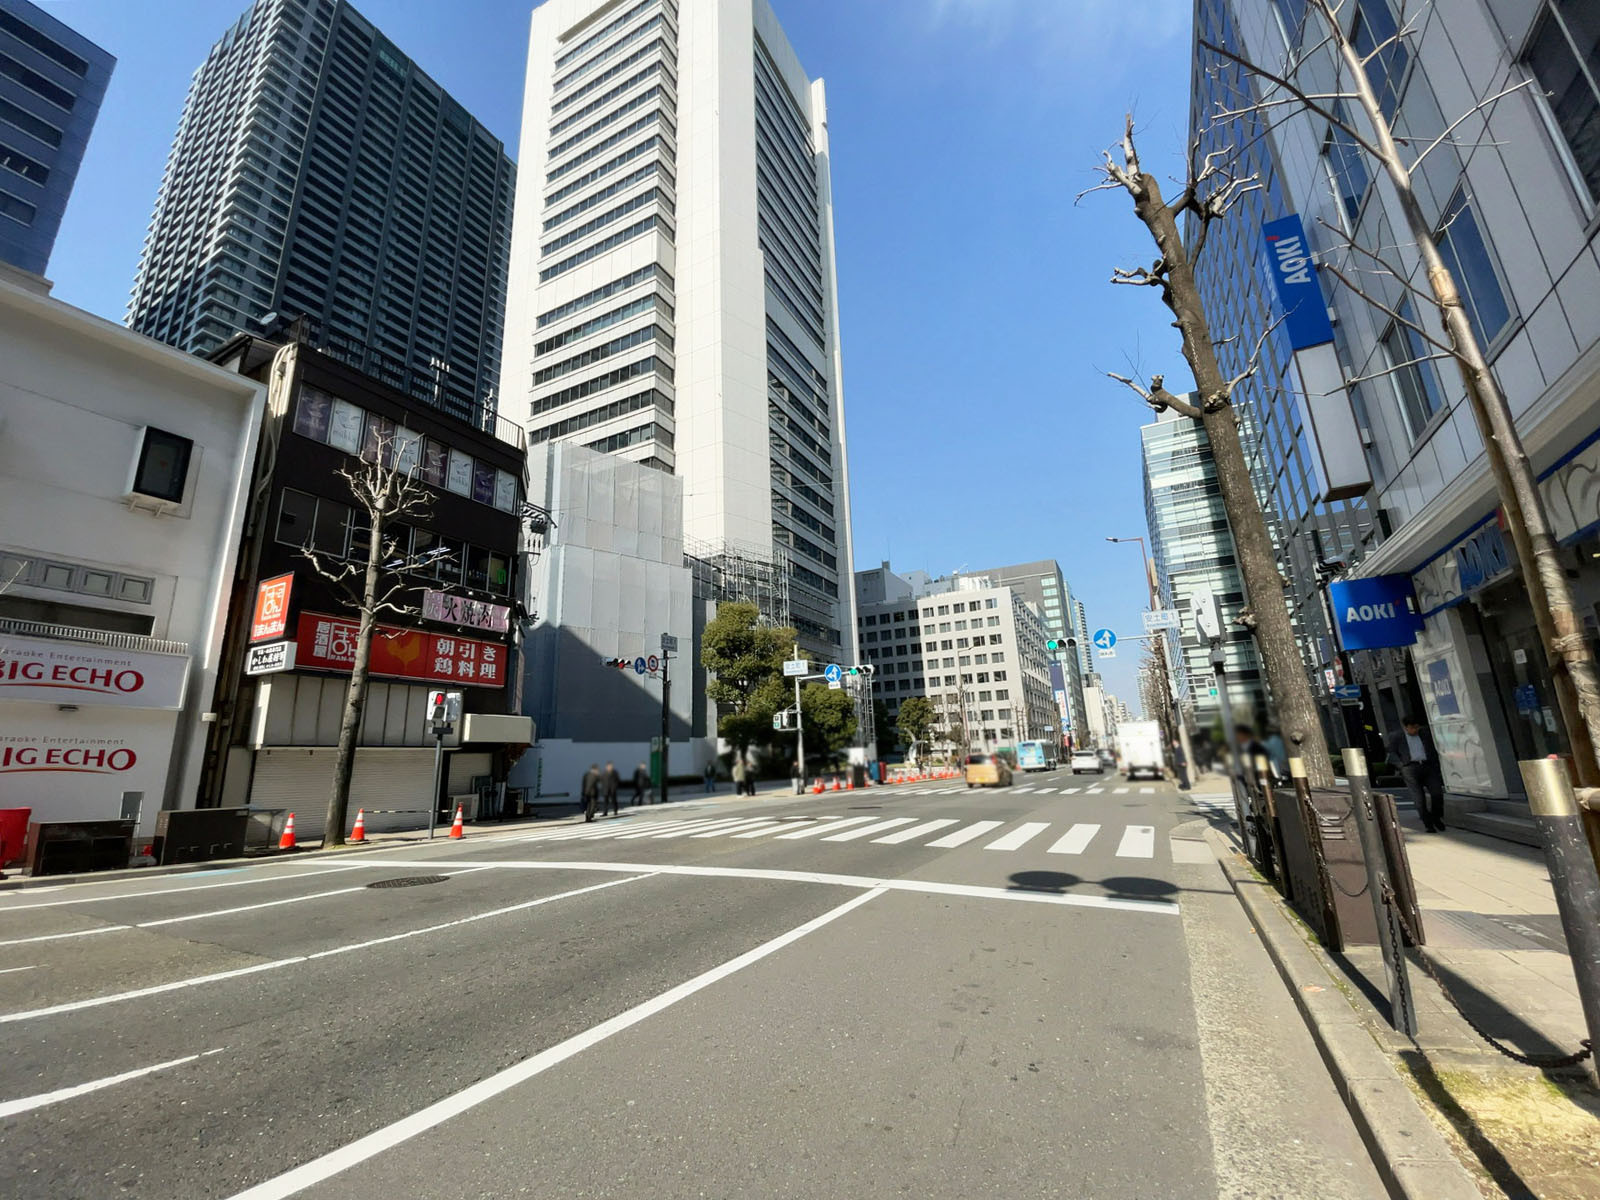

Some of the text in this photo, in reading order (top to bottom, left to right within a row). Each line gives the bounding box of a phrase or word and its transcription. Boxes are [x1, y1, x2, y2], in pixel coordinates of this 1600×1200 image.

[1274, 235, 1311, 284] AOKI
[1457, 524, 1509, 592] AOKI
[1346, 603, 1396, 623] AOKI
[312, 621, 331, 658] 居酒屋
[436, 638, 497, 661] 朝引き
[50, 652, 131, 666] Entertainment
[433, 657, 497, 678] 鶏料理
[52, 665, 144, 692] ECHO
[43, 736, 124, 745] Entertainment
[46, 748, 137, 771] ECHO
